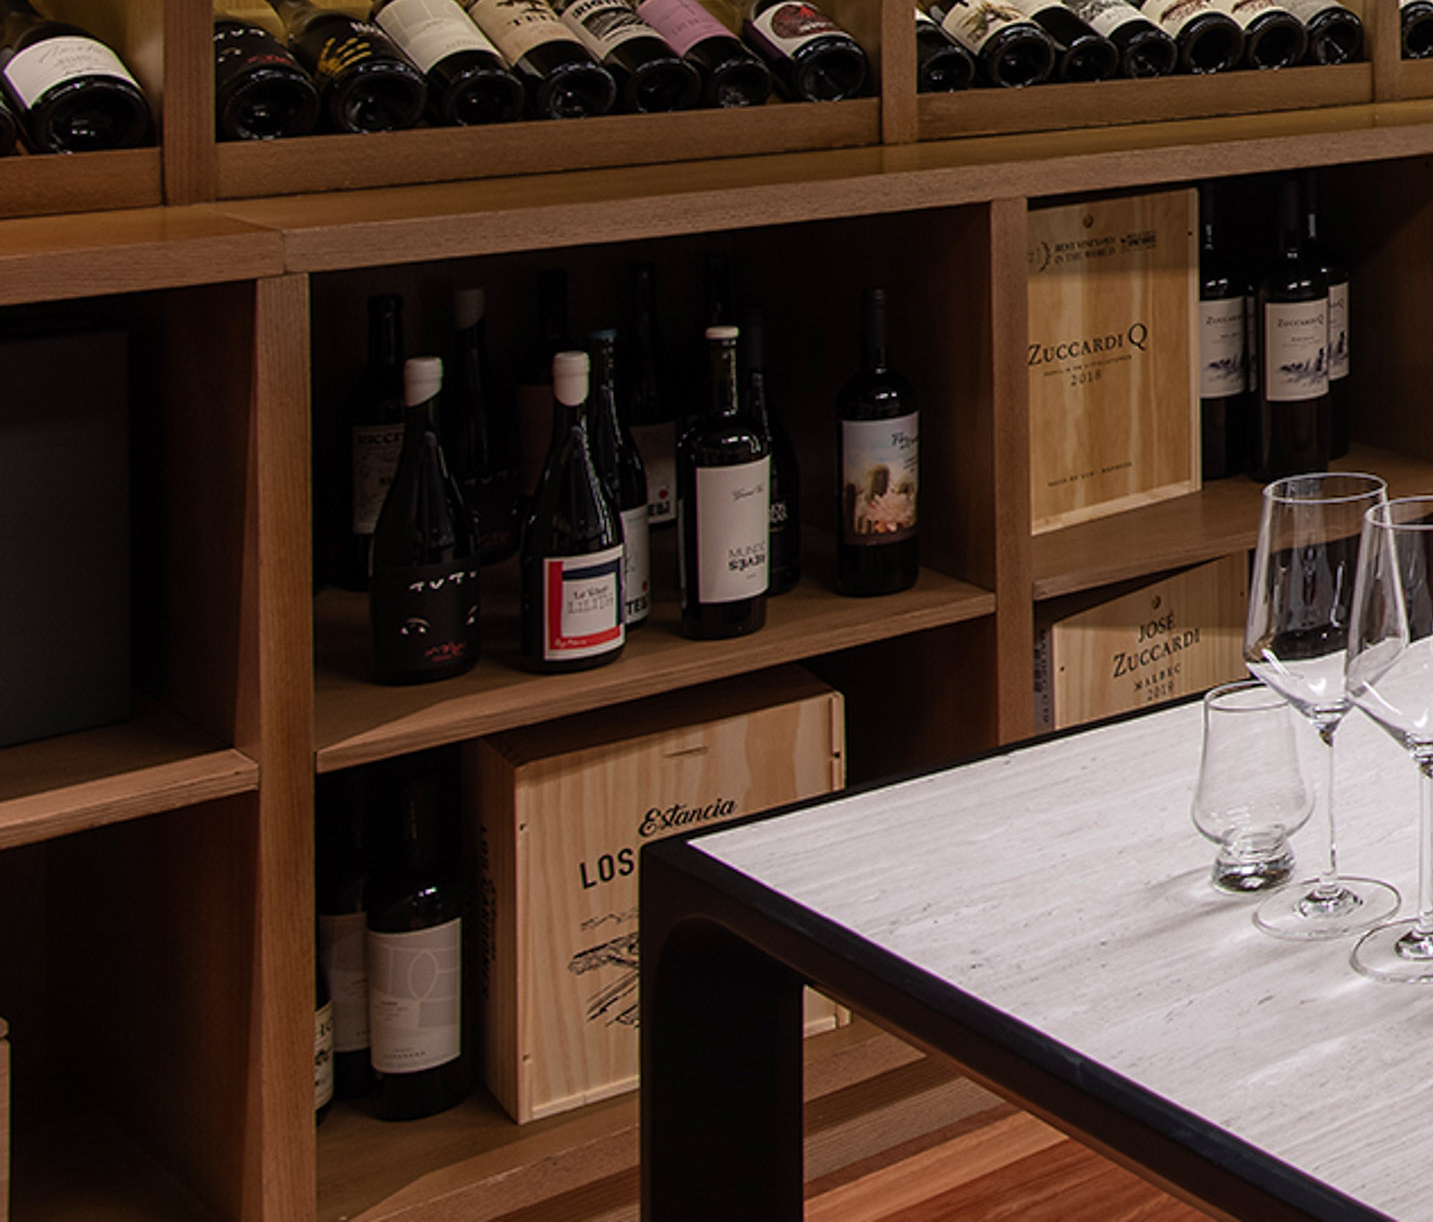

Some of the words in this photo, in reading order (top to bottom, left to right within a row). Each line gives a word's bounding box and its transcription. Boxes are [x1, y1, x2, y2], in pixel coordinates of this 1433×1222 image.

[1028, 334, 1124, 366] ZUCCARDI
[1128, 322, 1148, 352] Q
[1112, 628, 1200, 679] ZUCCARDI
[1133, 662, 1181, 692] MALBEC
[637, 797, 738, 837] Estancia
[579, 847, 635, 890] LOS
